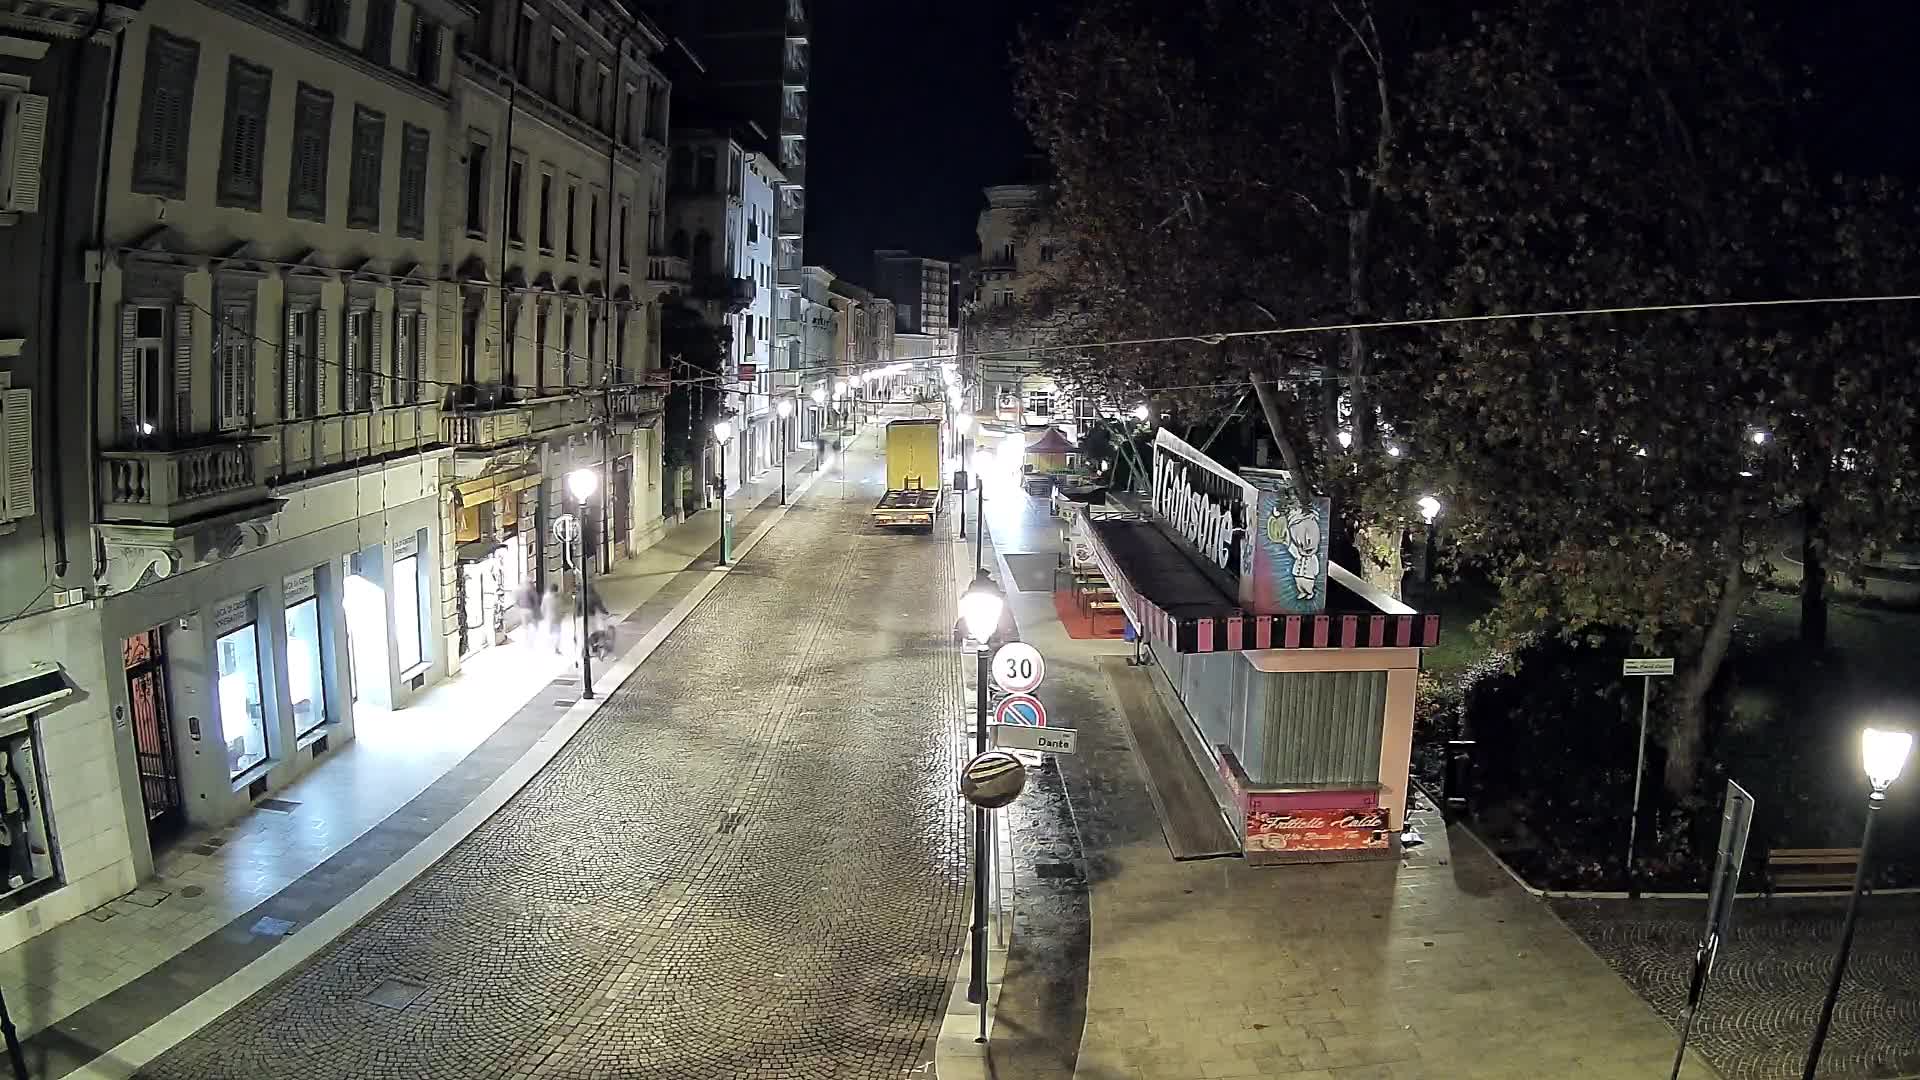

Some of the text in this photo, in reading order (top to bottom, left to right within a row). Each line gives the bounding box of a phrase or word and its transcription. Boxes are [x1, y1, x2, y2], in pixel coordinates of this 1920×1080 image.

[1162, 458, 1233, 569] Golosone
[1006, 658, 1032, 679] 30
[1038, 737, 1069, 749] Dante
